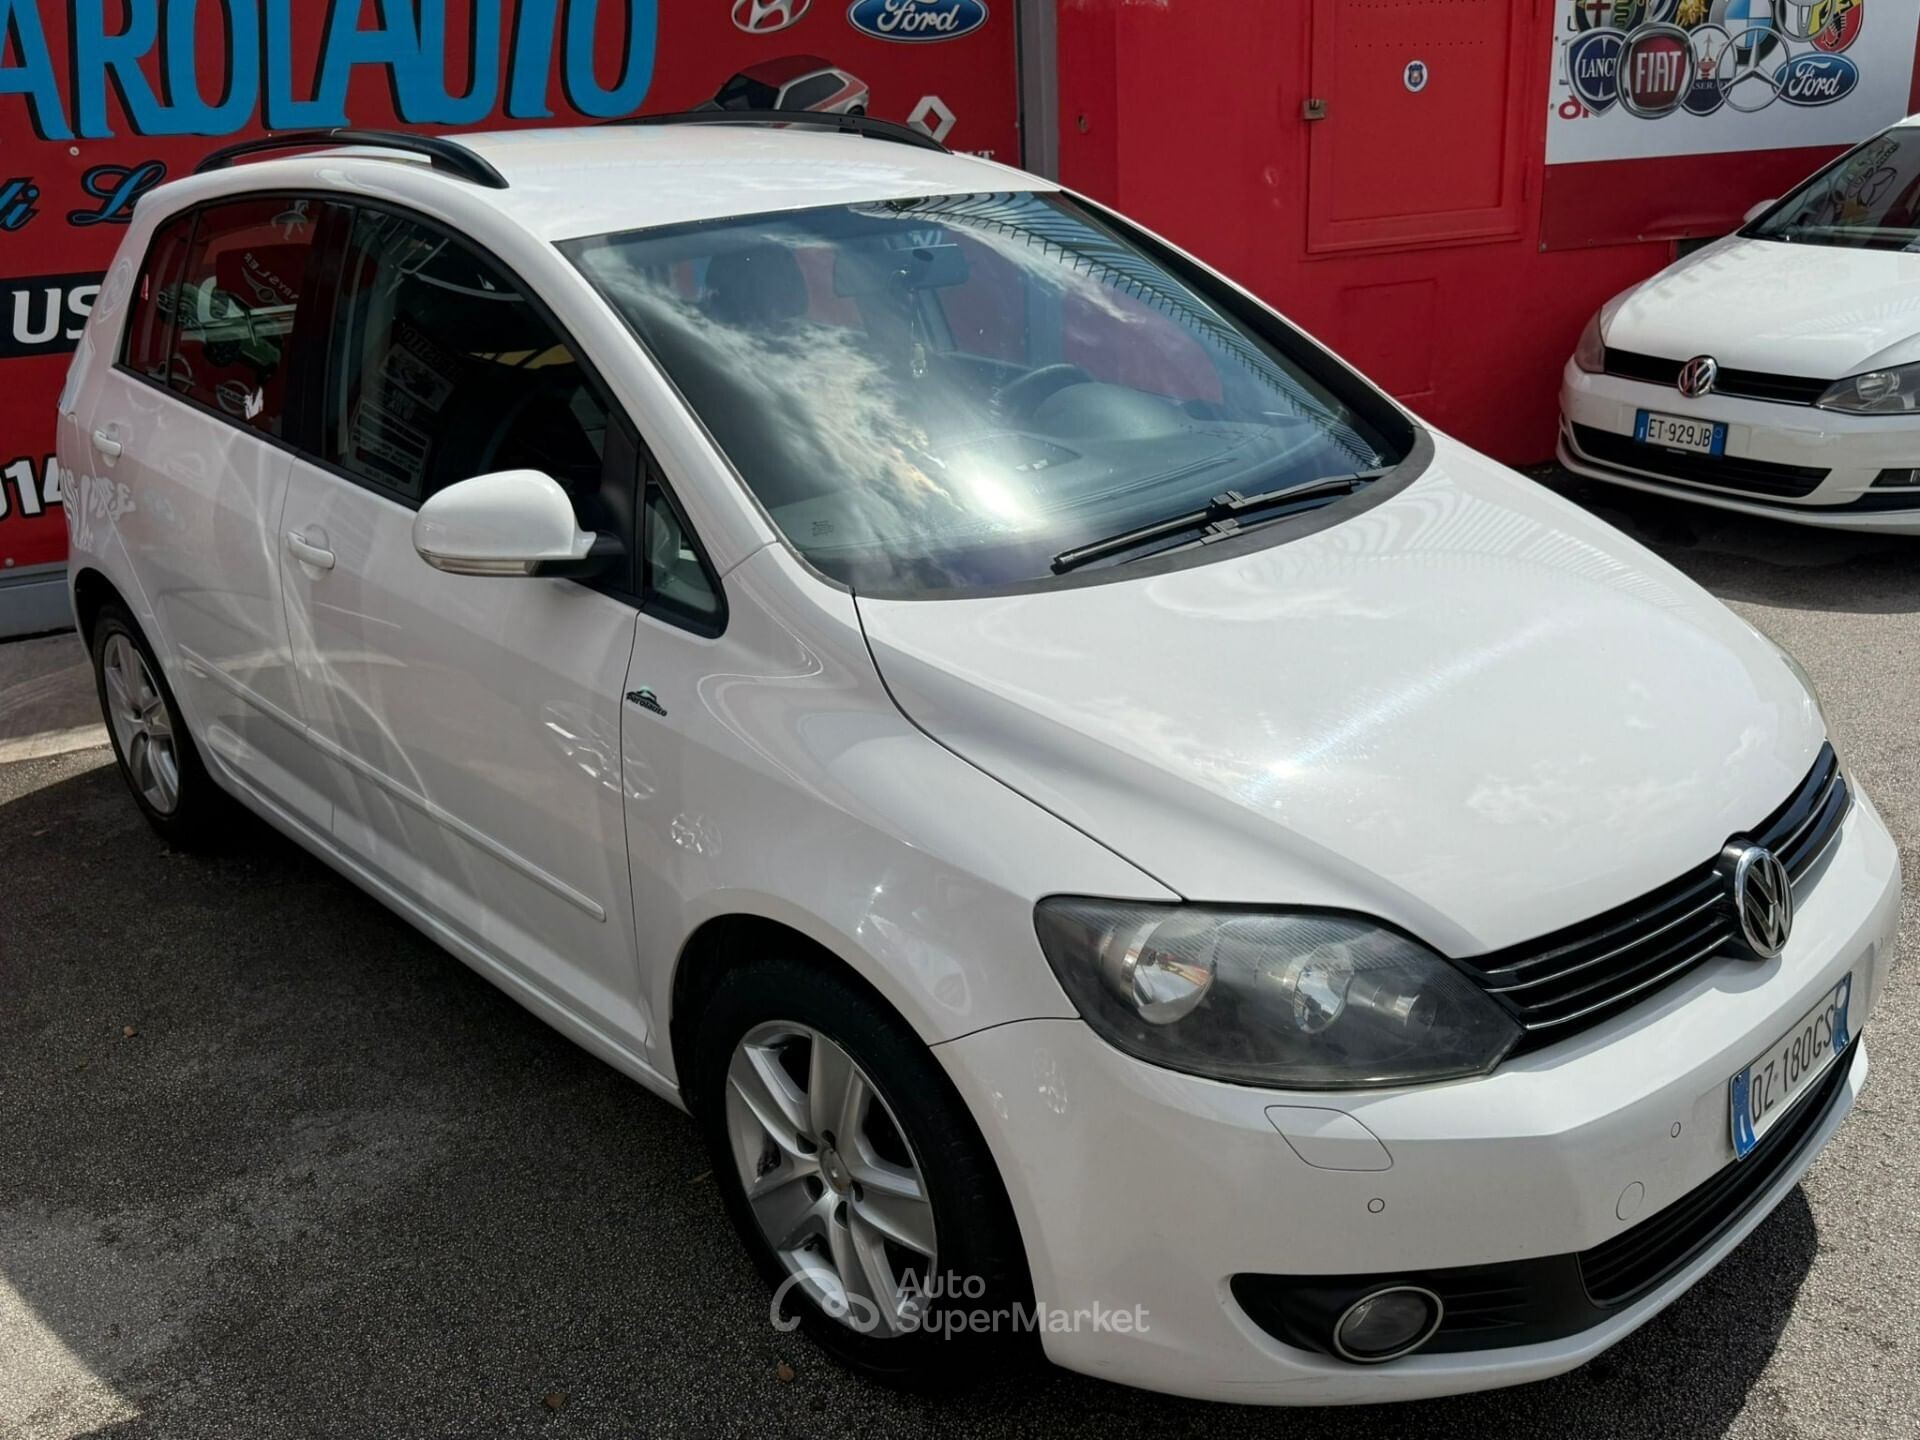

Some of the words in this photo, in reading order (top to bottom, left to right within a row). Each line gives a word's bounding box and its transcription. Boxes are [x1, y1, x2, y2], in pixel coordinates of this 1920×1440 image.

[877, 0, 960, 32] Ford
[1635, 51, 1682, 94] FIAT
[1788, 61, 1842, 96] Ford
